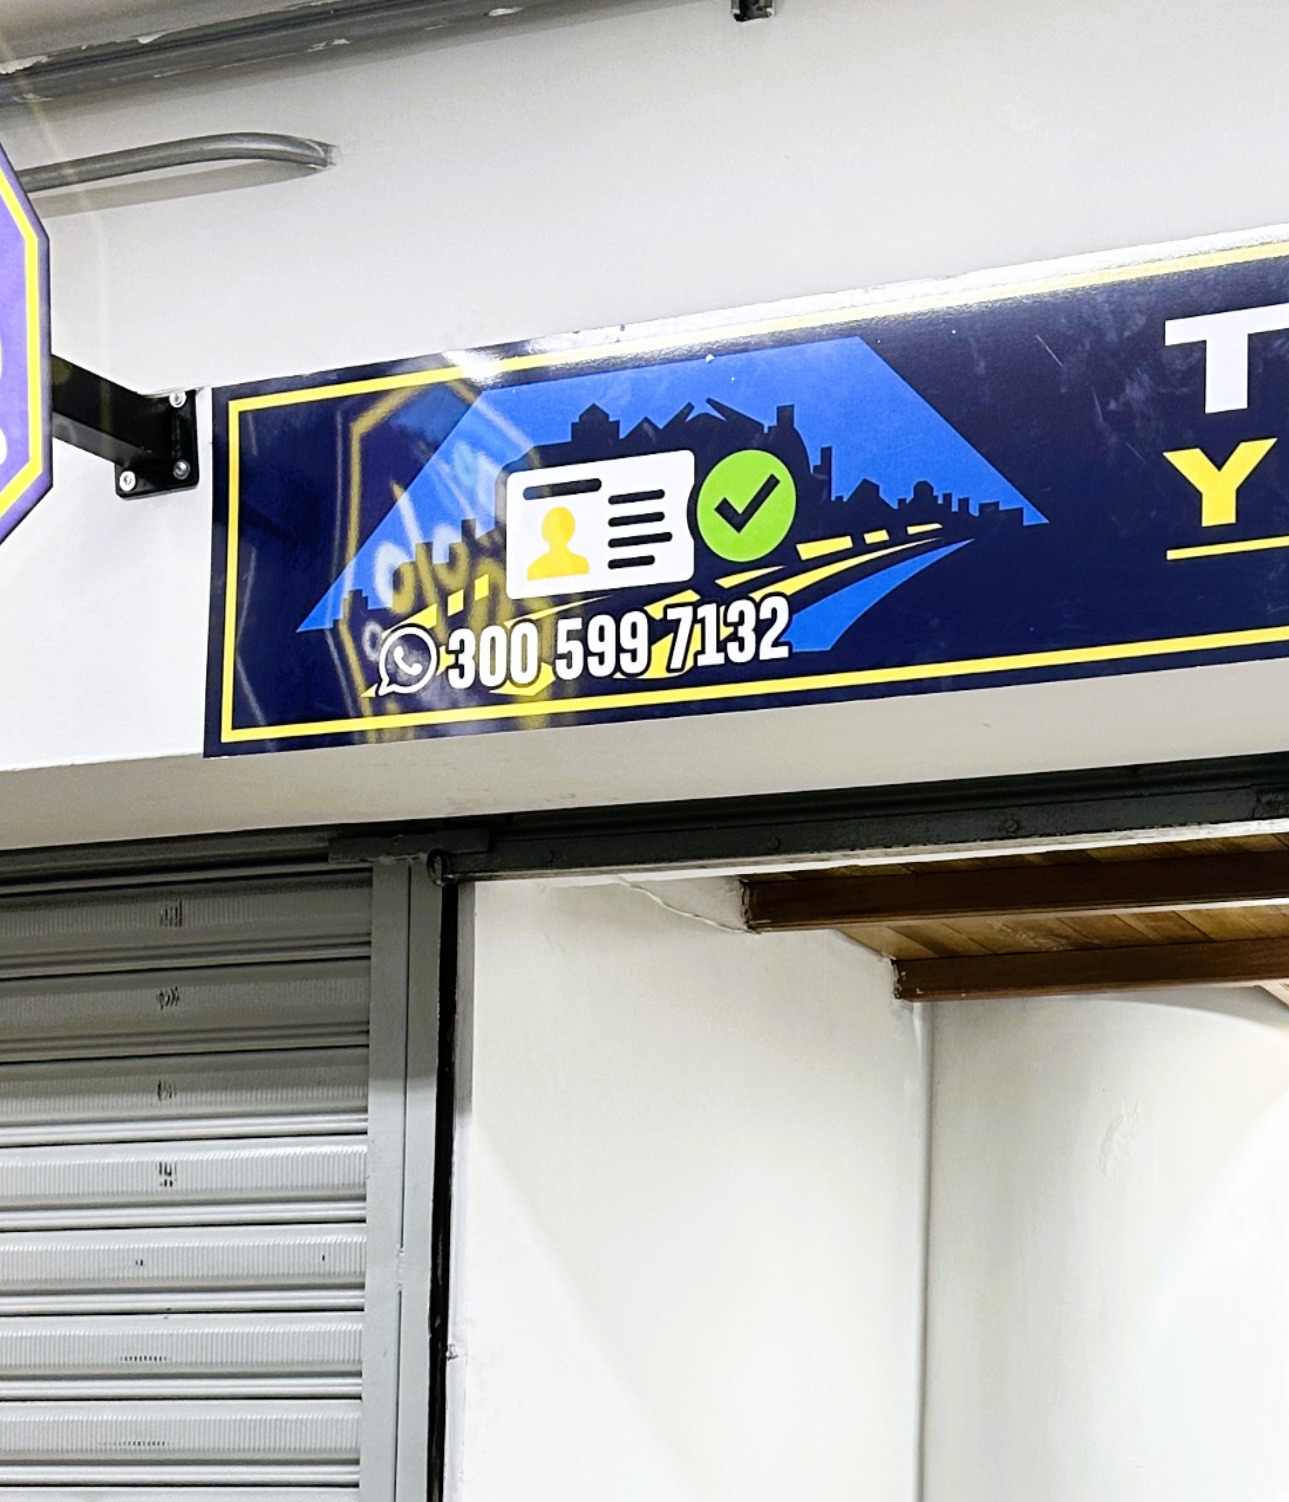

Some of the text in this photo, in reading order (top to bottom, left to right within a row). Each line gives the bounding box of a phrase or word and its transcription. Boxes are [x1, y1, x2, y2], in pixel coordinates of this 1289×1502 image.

[1164, 440, 1277, 525] Y
[446, 596, 790, 690] 300 599 7132
